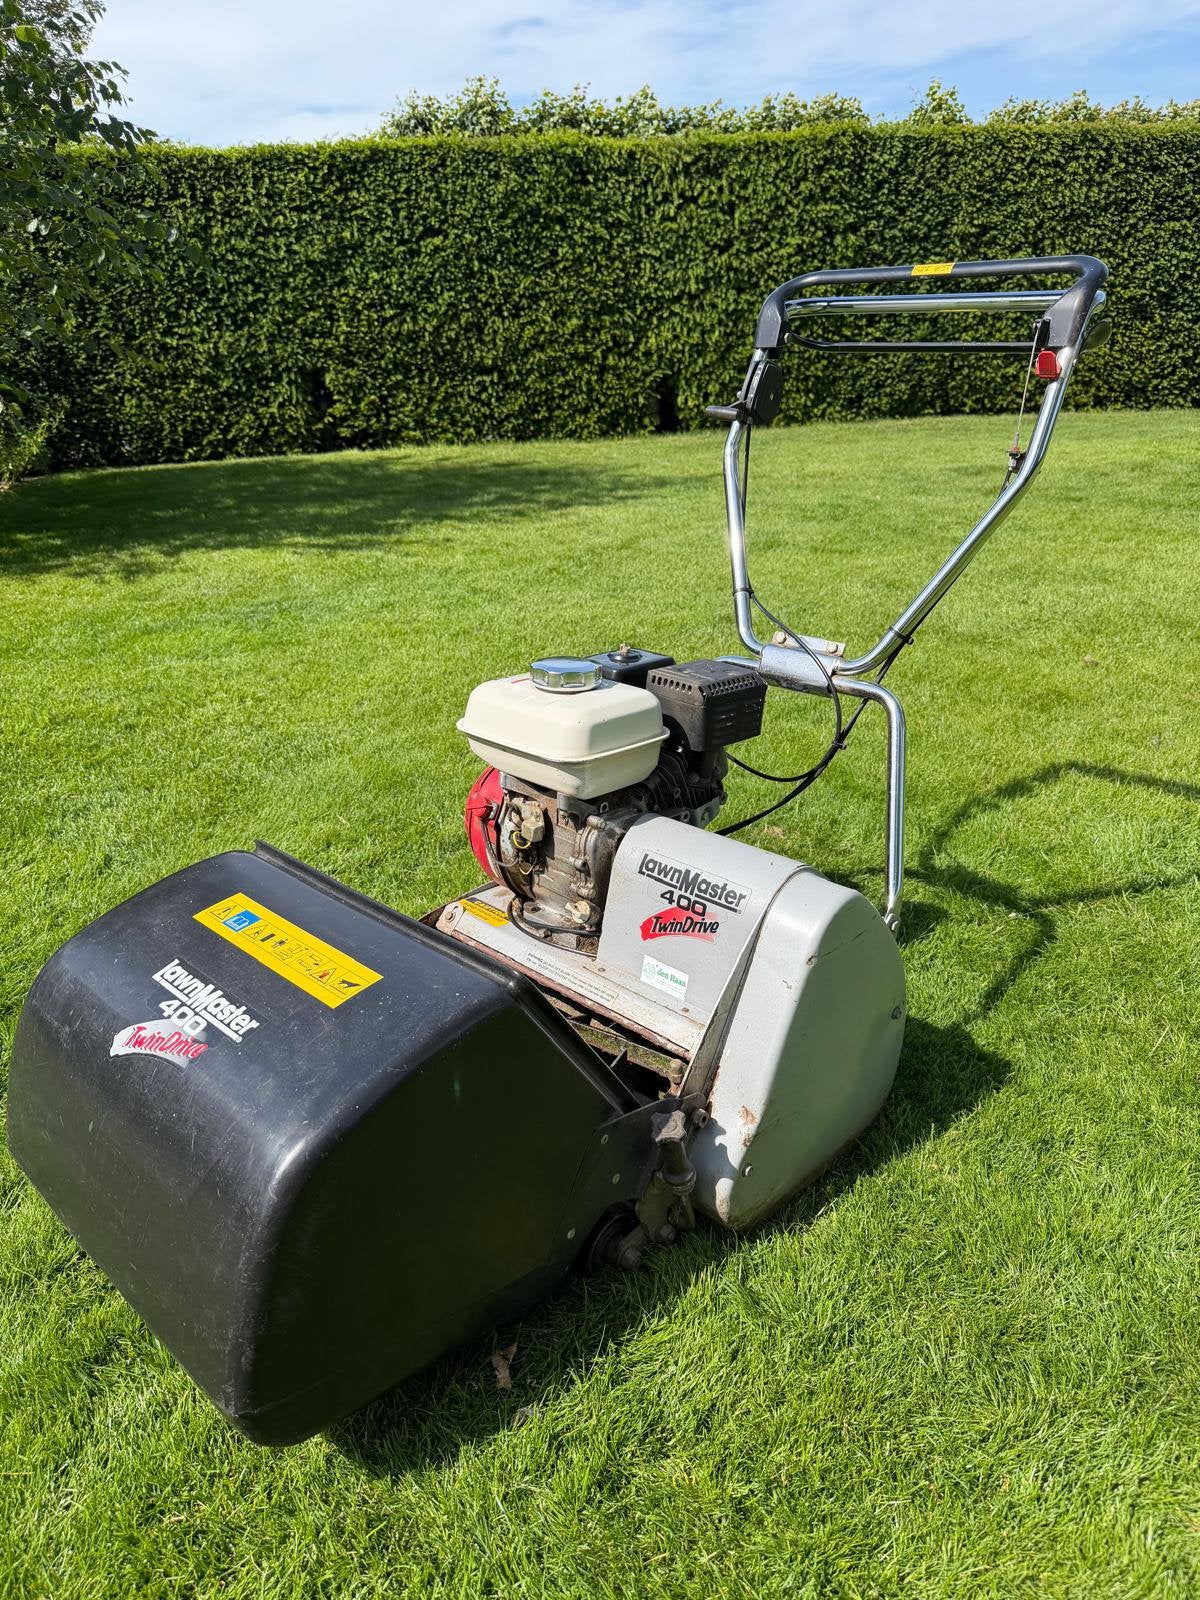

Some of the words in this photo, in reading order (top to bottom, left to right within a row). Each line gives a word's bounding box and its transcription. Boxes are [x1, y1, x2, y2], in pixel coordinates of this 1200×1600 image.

[638, 853, 746, 911] LawnMaster
[660, 890, 706, 916] 400
[651, 915, 719, 934] TwinDrive
[152, 959, 260, 1040] LawnMaster
[159, 1000, 207, 1036] 400
[124, 1026, 207, 1059] TwinDrive
